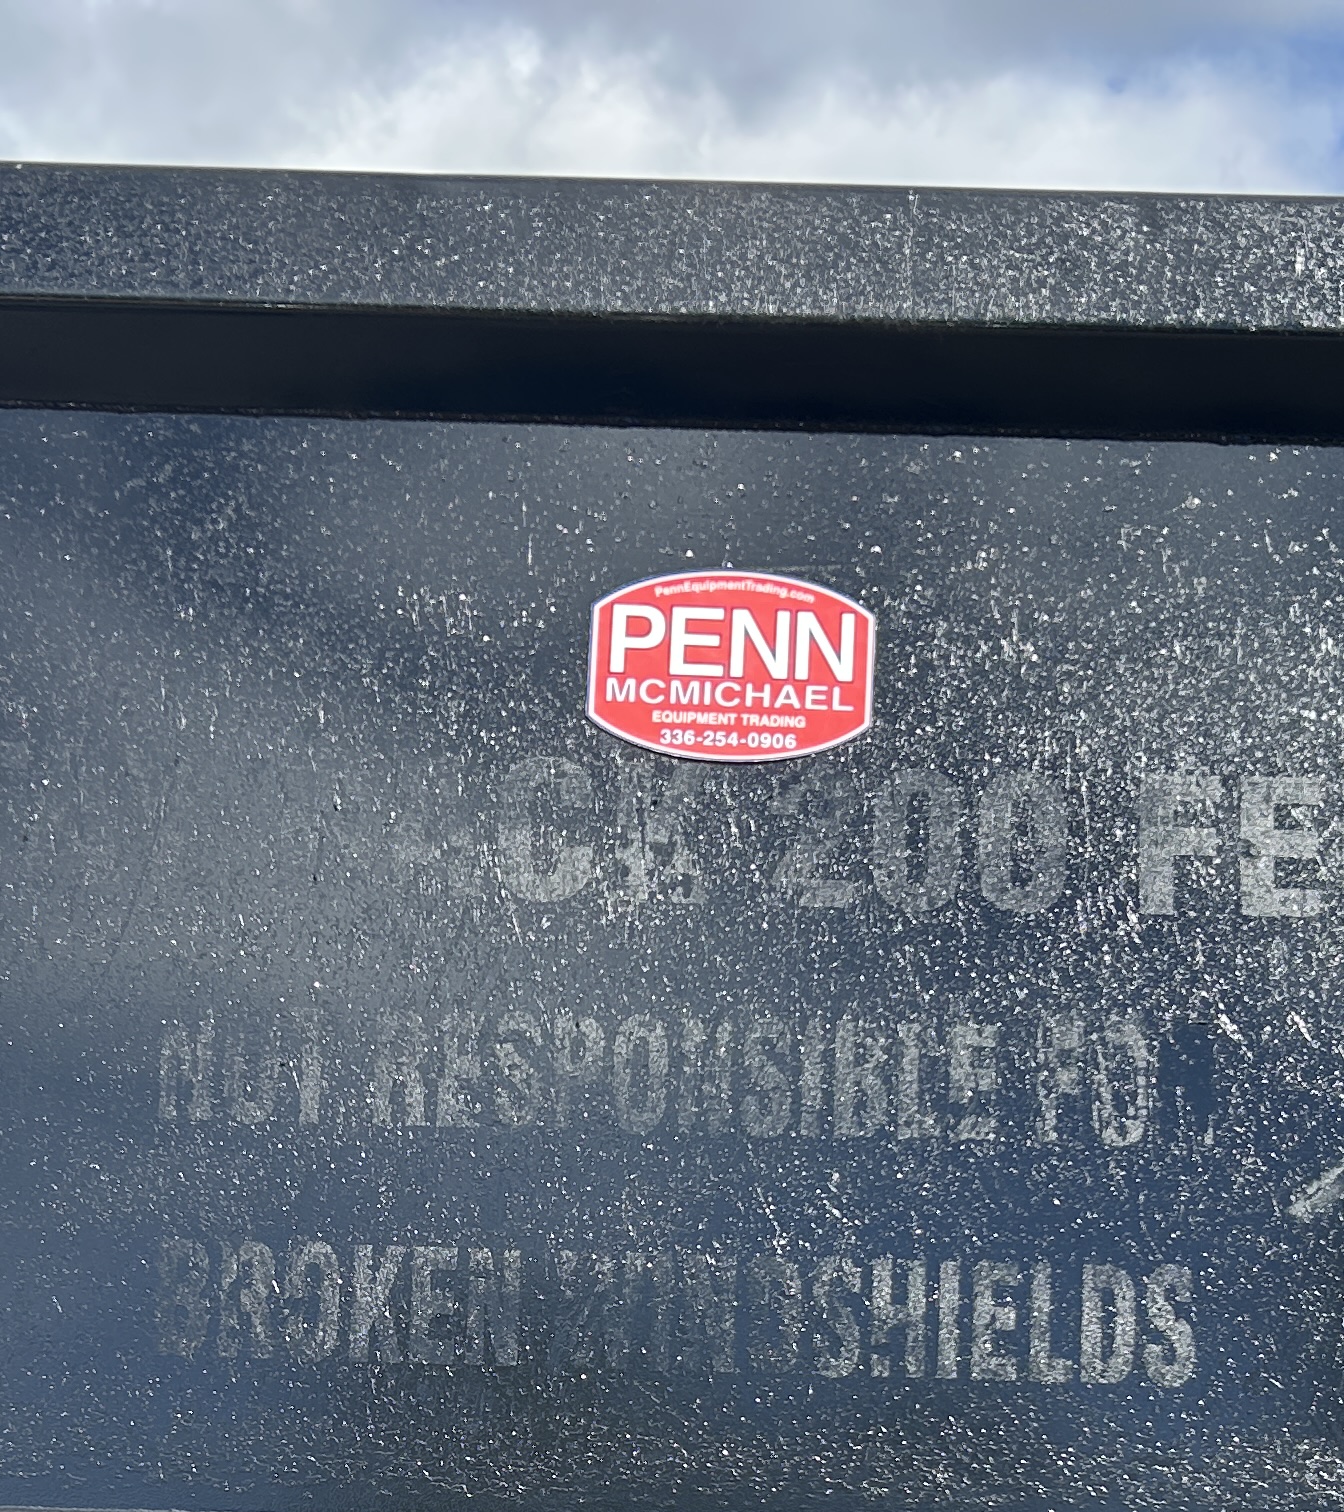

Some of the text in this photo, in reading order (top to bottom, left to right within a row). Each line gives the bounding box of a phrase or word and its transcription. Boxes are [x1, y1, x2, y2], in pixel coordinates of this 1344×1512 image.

[654, 579, 815, 604] PennEquipmentTrading.com
[609, 603, 856, 682] PENN
[606, 677, 854, 711] MCMICHAEL
[651, 709, 807, 729] EQUIPMENT TRADING
[659, 728, 798, 750] 336-254-0906
[364, 1008, 999, 1142] RESPONSIBLE
[158, 1236, 524, 1370] BROKEN
